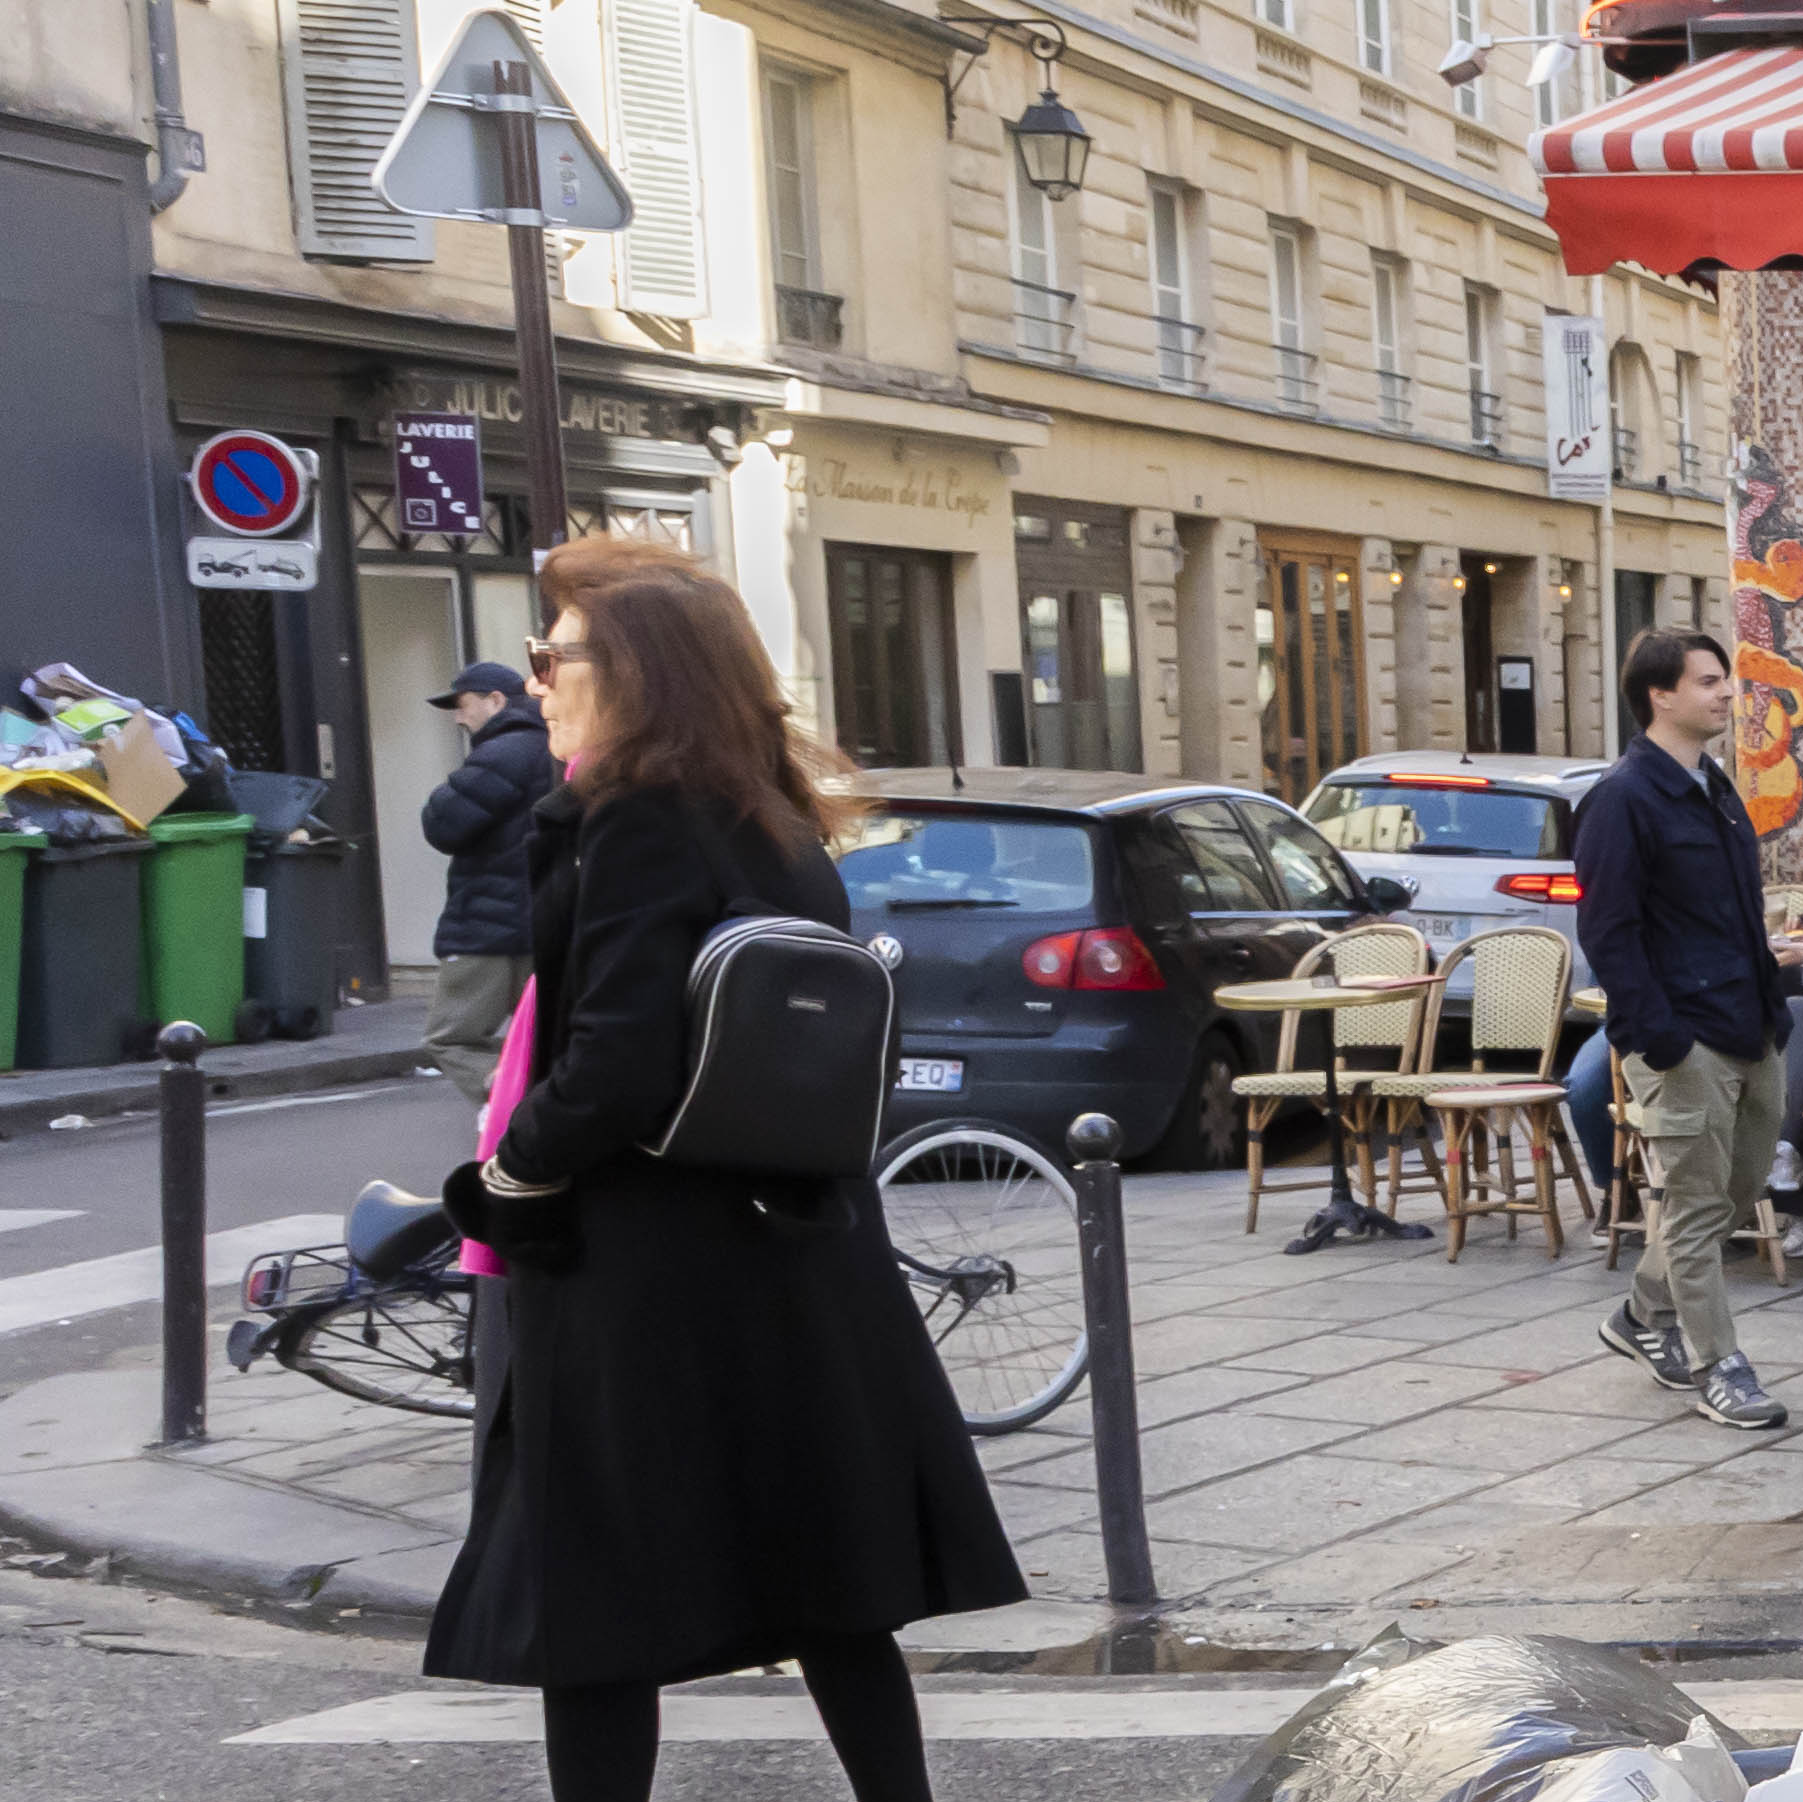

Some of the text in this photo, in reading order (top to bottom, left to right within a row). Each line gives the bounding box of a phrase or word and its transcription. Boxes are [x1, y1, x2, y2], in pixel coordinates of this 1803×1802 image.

[397, 422, 476, 440] LAVERIE
[558, 393, 652, 438] LAVERIE
[824, 458, 894, 504] Maison
